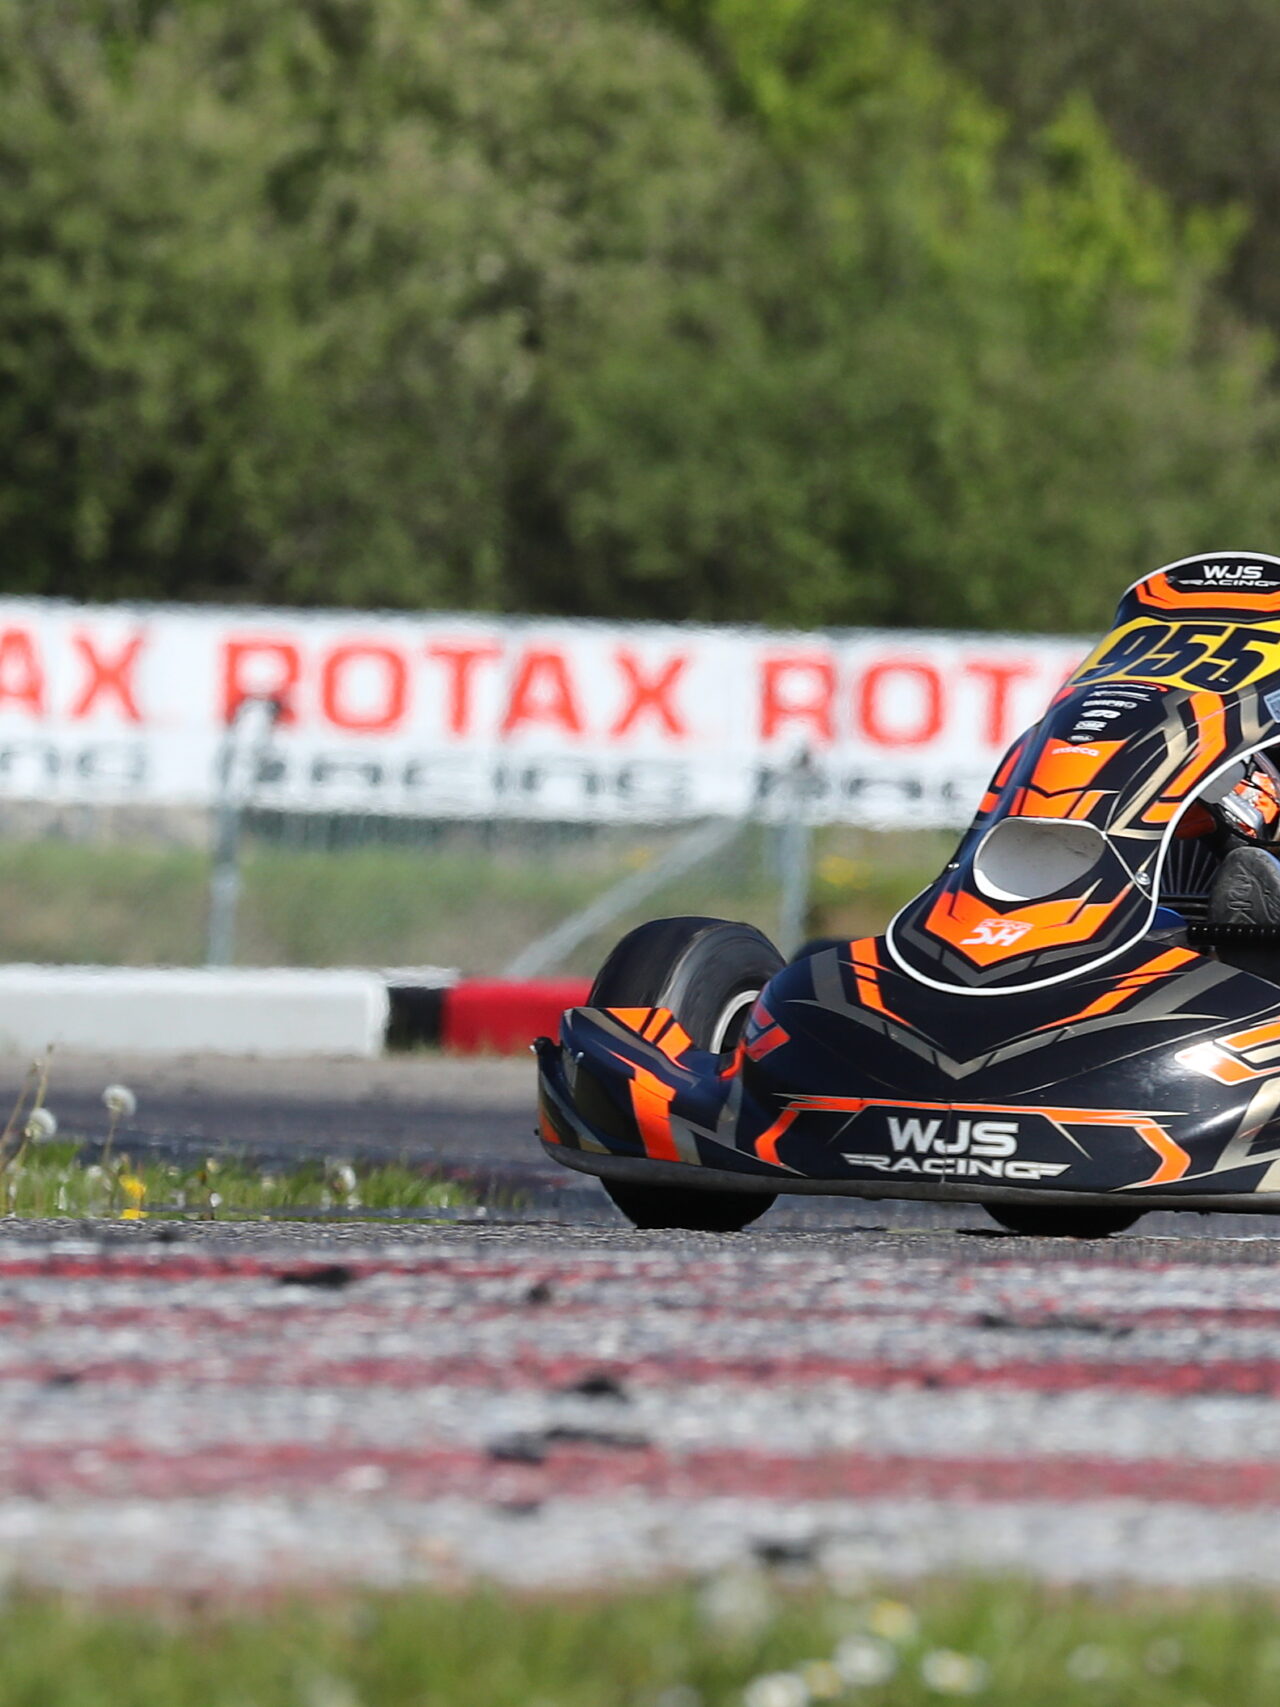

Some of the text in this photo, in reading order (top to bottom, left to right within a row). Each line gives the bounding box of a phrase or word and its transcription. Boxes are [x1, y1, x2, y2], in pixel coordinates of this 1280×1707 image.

[1203, 564, 1264, 580] WJS
[218, 635, 690, 741] ROTAX
[759, 652, 1080, 750] ROT
[886, 1116, 1020, 1158] WJS
[840, 1152, 1072, 1181] RACING
